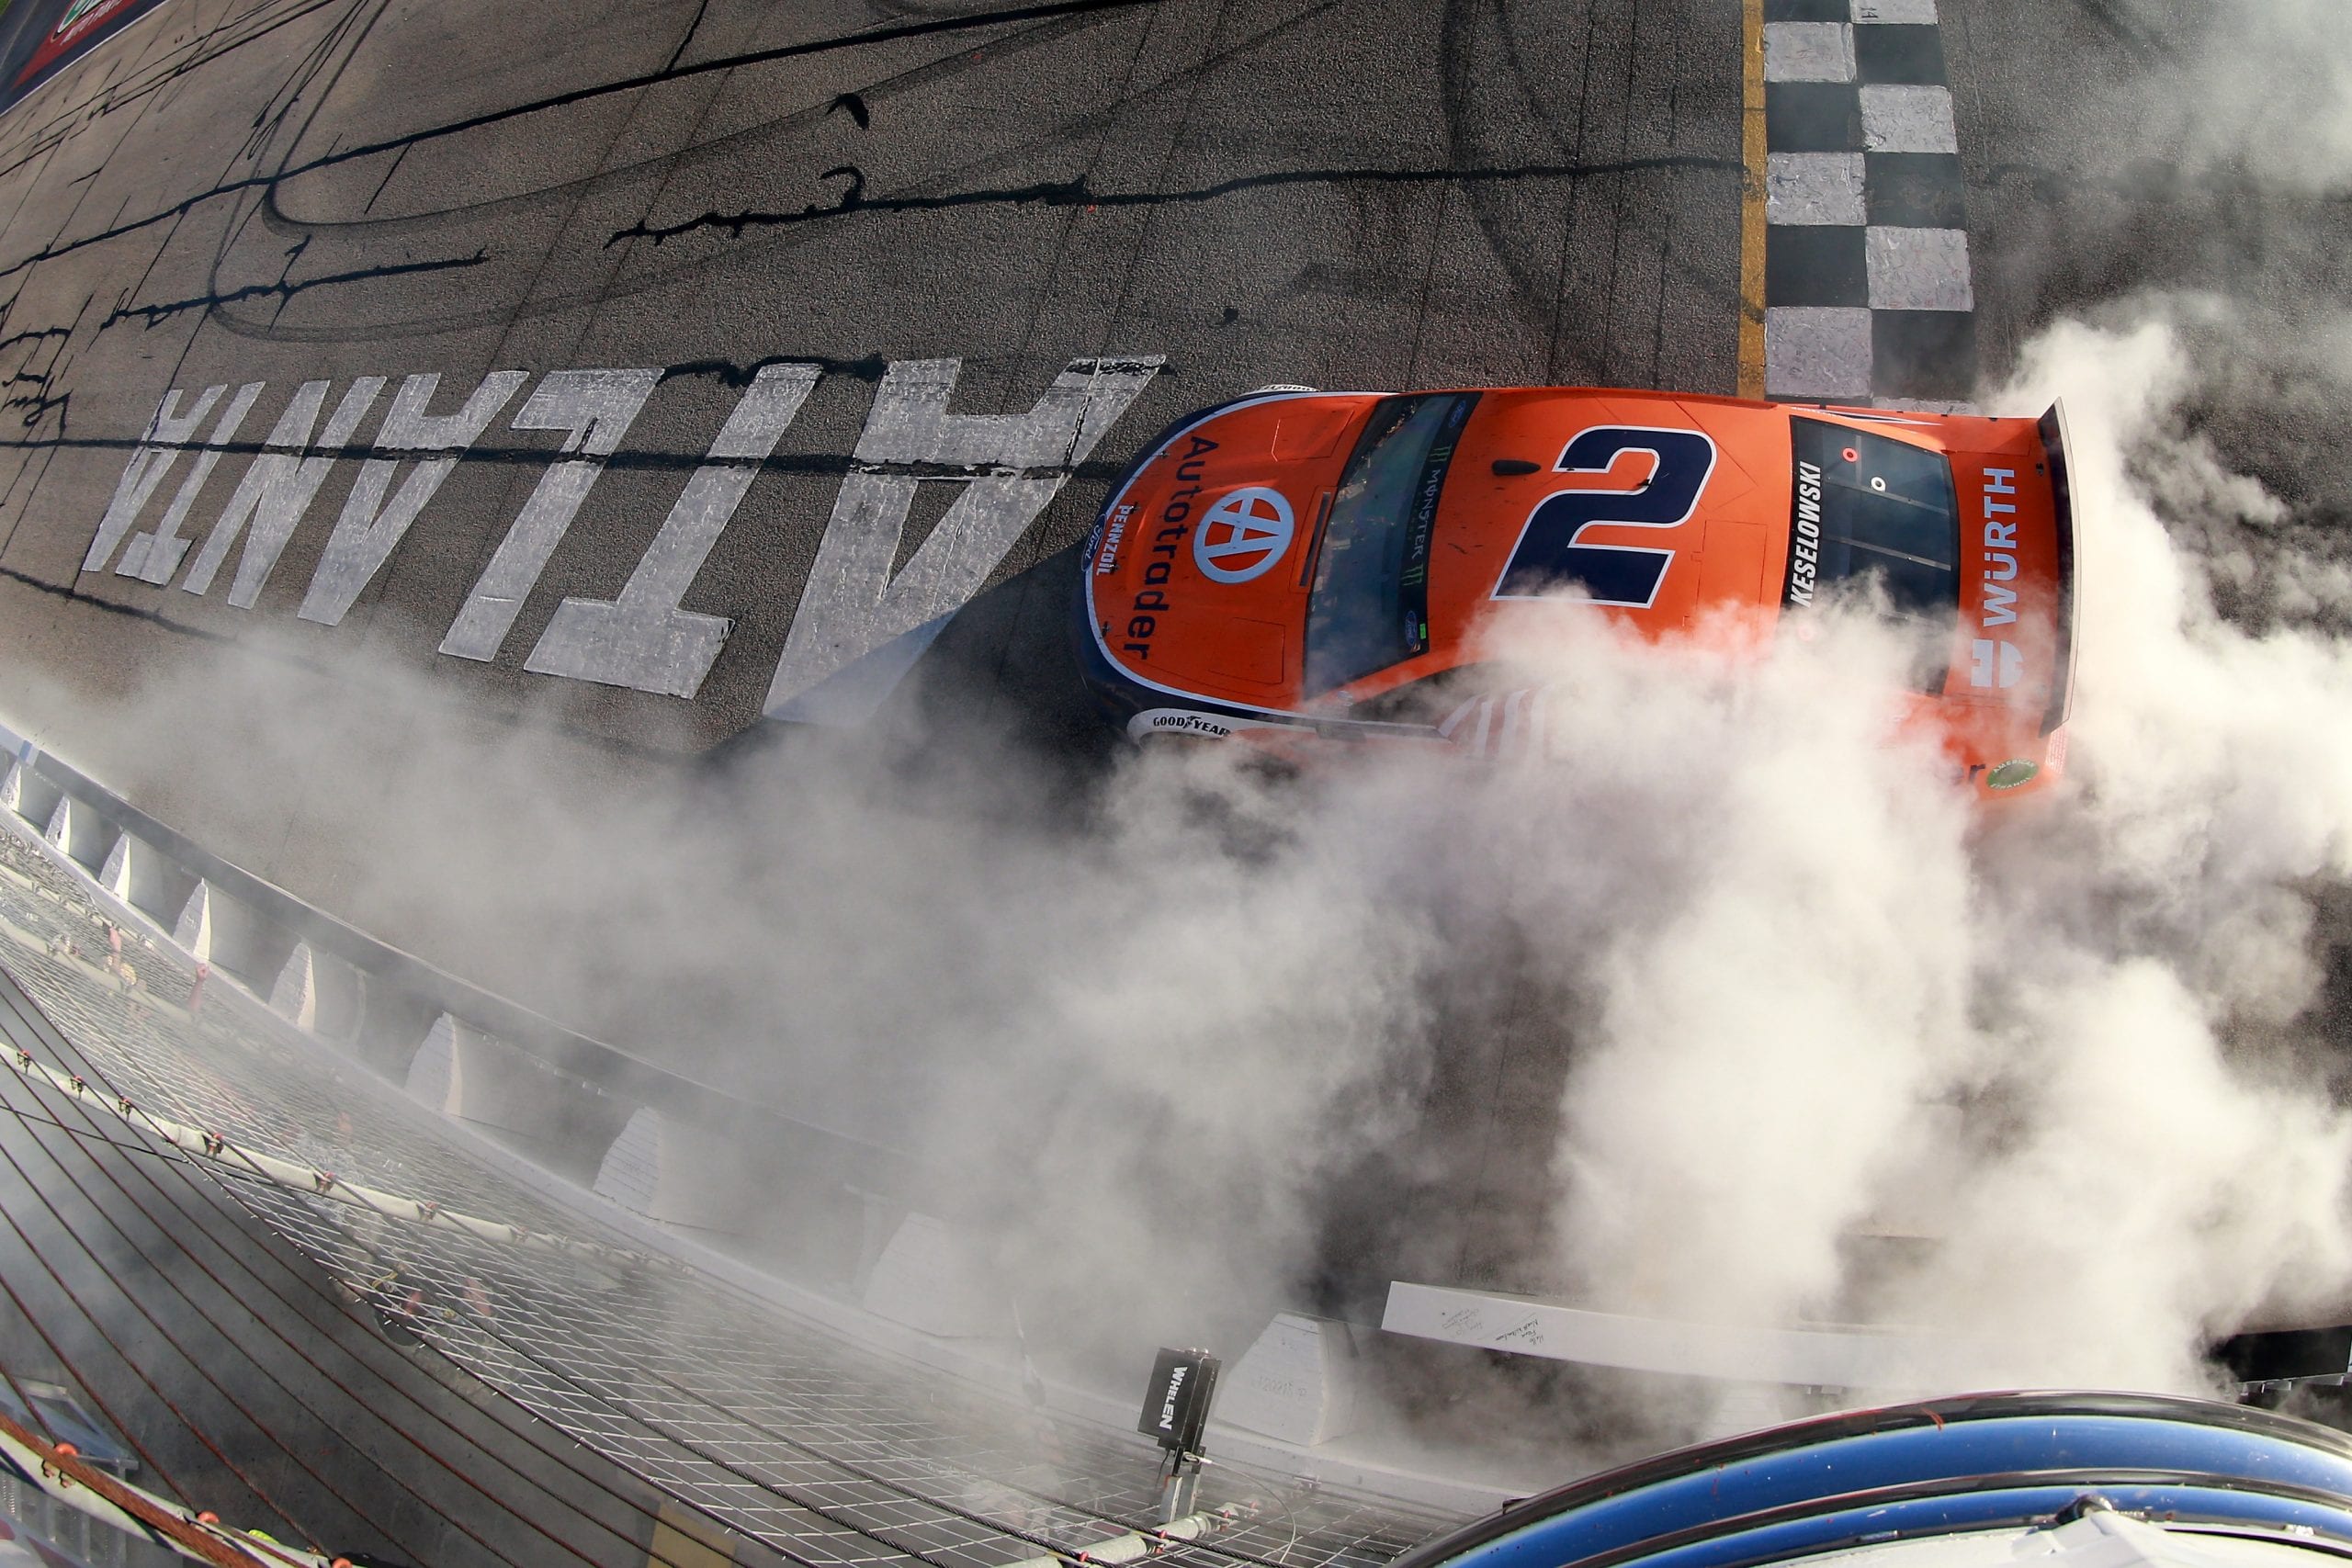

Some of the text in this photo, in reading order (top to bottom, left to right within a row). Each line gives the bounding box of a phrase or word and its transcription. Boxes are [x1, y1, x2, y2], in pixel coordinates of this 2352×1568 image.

[83, 354, 1169, 722] ATLANTA
[1084, 525, 1102, 559] Ford
[1096, 505, 1134, 577] PENNZOIL
[1123, 435, 1220, 660] Autotrader
[1411, 468, 1442, 560] MONSTER
[1487, 423, 1718, 610] 2
[1790, 460, 1822, 609] KESELOWSKI
[1983, 467, 2018, 626] WÜRTH
[1152, 715, 1232, 738] GOODYEAR
[1159, 1366, 1189, 1431] WHELEN
